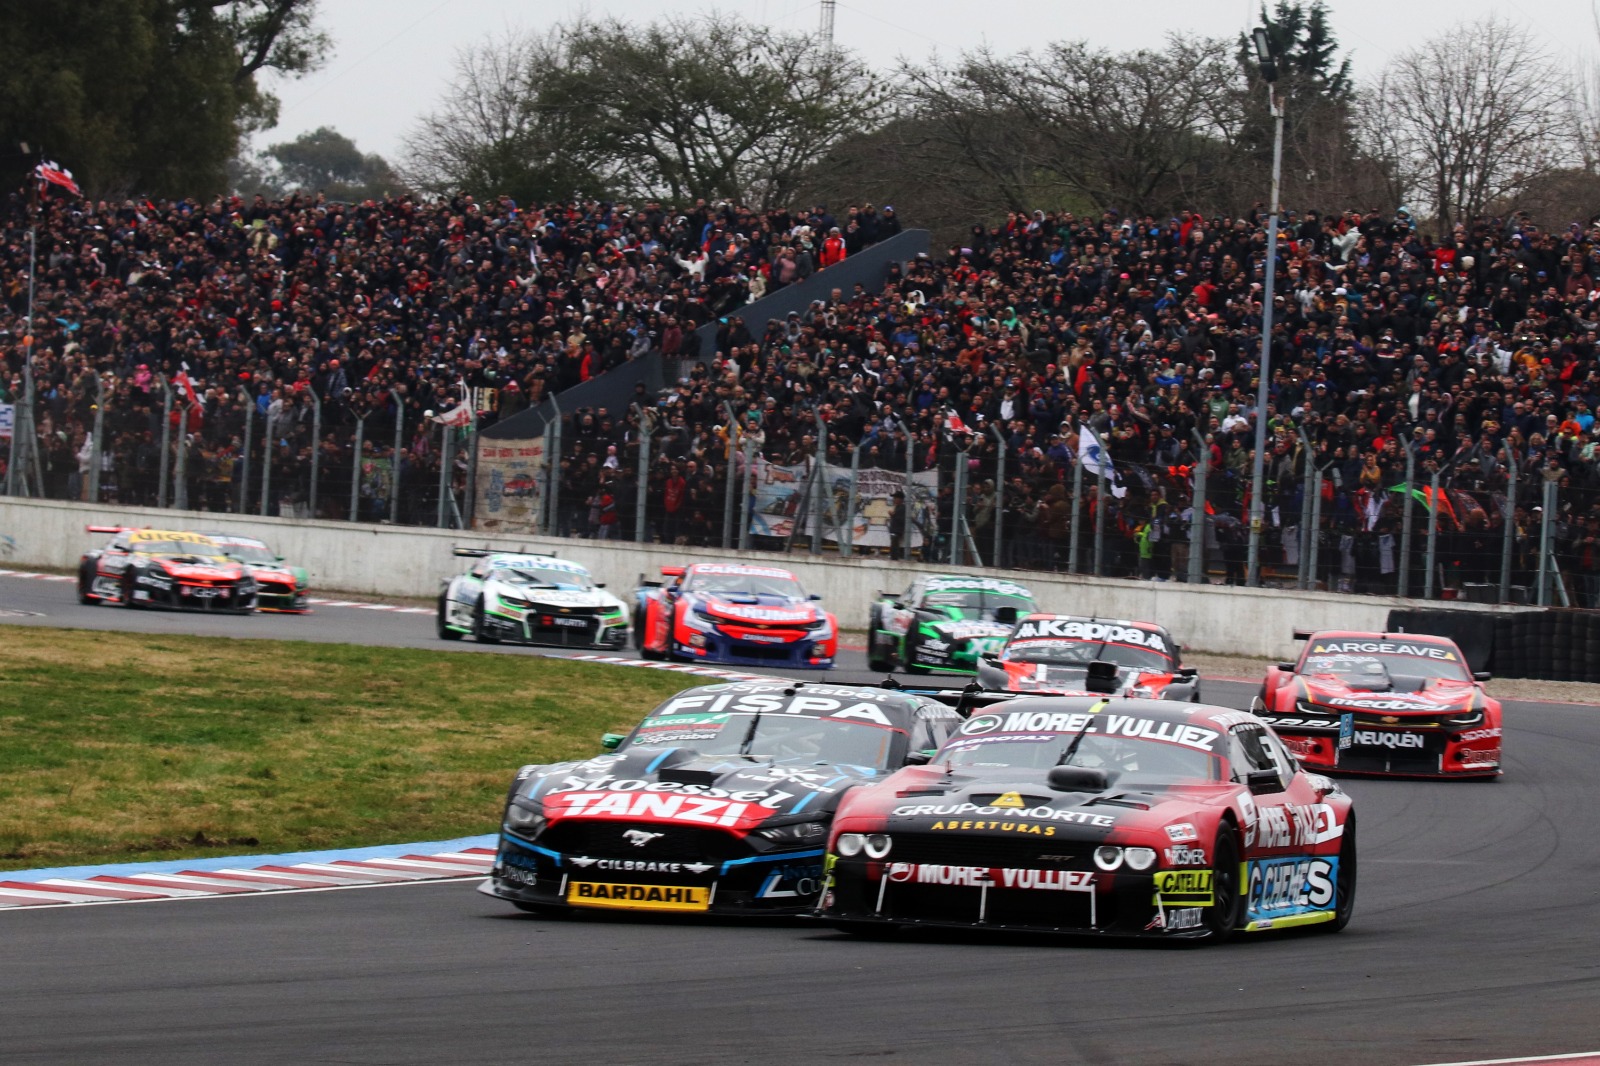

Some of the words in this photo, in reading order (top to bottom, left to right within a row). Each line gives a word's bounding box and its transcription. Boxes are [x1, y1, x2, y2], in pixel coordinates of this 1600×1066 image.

[1037, 619, 1146, 643] Kappa
[1325, 642, 1446, 660] ARGEAVE
[660, 694, 893, 726] FISPA
[644, 717, 697, 727] Lucas
[1001, 712, 1098, 733] MOREL
[1104, 714, 1219, 751] VULLIEZ
[646, 732, 717, 745] Sportsbet
[1353, 730, 1424, 749] NEUQUÉN
[545, 774, 795, 809] Stoessel
[562, 793, 749, 827] TANZI
[892, 803, 999, 817] GRUPO
[1003, 806, 1115, 828] NORTE
[931, 820, 1056, 837] ABERTURAS
[597, 859, 681, 873] CILBRAKE
[917, 864, 995, 887] MOREL
[1002, 868, 1095, 892] VULLIEZ
[578, 883, 700, 904] BARDAHL
